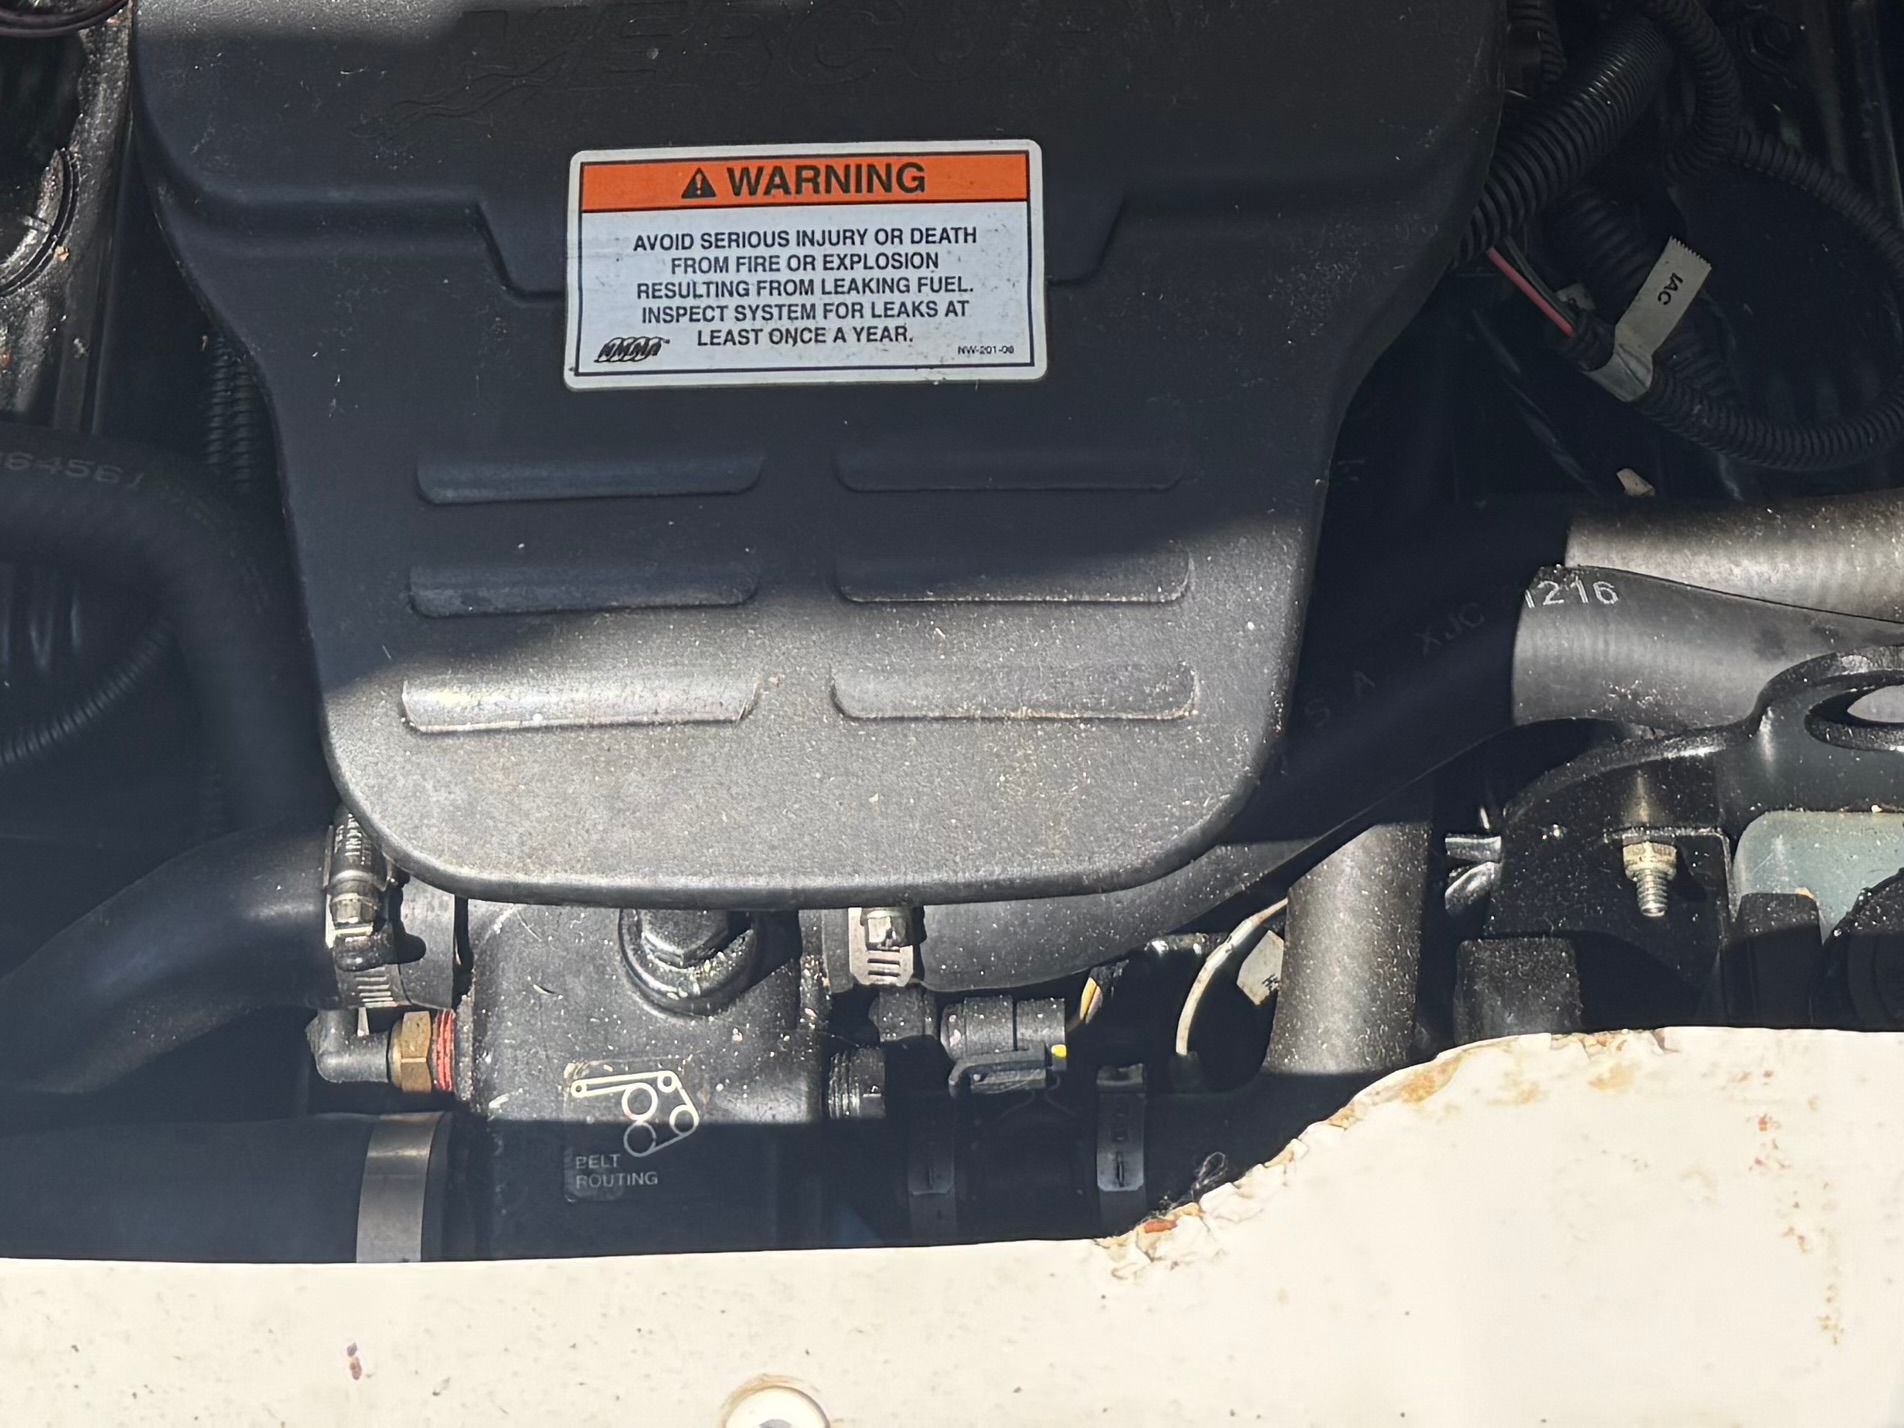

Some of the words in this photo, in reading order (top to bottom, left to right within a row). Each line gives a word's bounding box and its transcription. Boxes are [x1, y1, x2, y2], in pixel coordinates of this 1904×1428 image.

[726, 162, 926, 197] WARNING
[633, 233, 695, 252] AVOID
[700, 230, 791, 250] SERIOUS
[796, 228, 868, 248] INJURY
[874, 227, 904, 246] OR
[910, 226, 977, 245] DEATH
[671, 256, 729, 275] FROM
[736, 255, 781, 274] FIRE
[787, 254, 816, 273] OR
[823, 252, 939, 272] EXPLOSION
[637, 280, 750, 300] RESULTING
[756, 278, 815, 298] FROM
[821, 276, 911, 296] LEAKING
[917, 275, 975, 294] FUEL.
[1657, 272, 1684, 306] IAC
[642, 305, 729, 324] INSPECT
[734, 303, 816, 322] SYSTEM
[823, 301, 865, 320] FOR
[871, 300, 939, 319] LEAKS
[944, 299, 970, 318] AT
[697, 328, 764, 347] LEAST
[768, 326, 827, 347] ONCE
[832, 326, 847, 344] A
[852, 325, 914, 344] YEAR.
[1522, 575, 1620, 609] 1216
[575, 1152, 622, 1170] BELT
[575, 1170, 659, 1190] ROUTING
